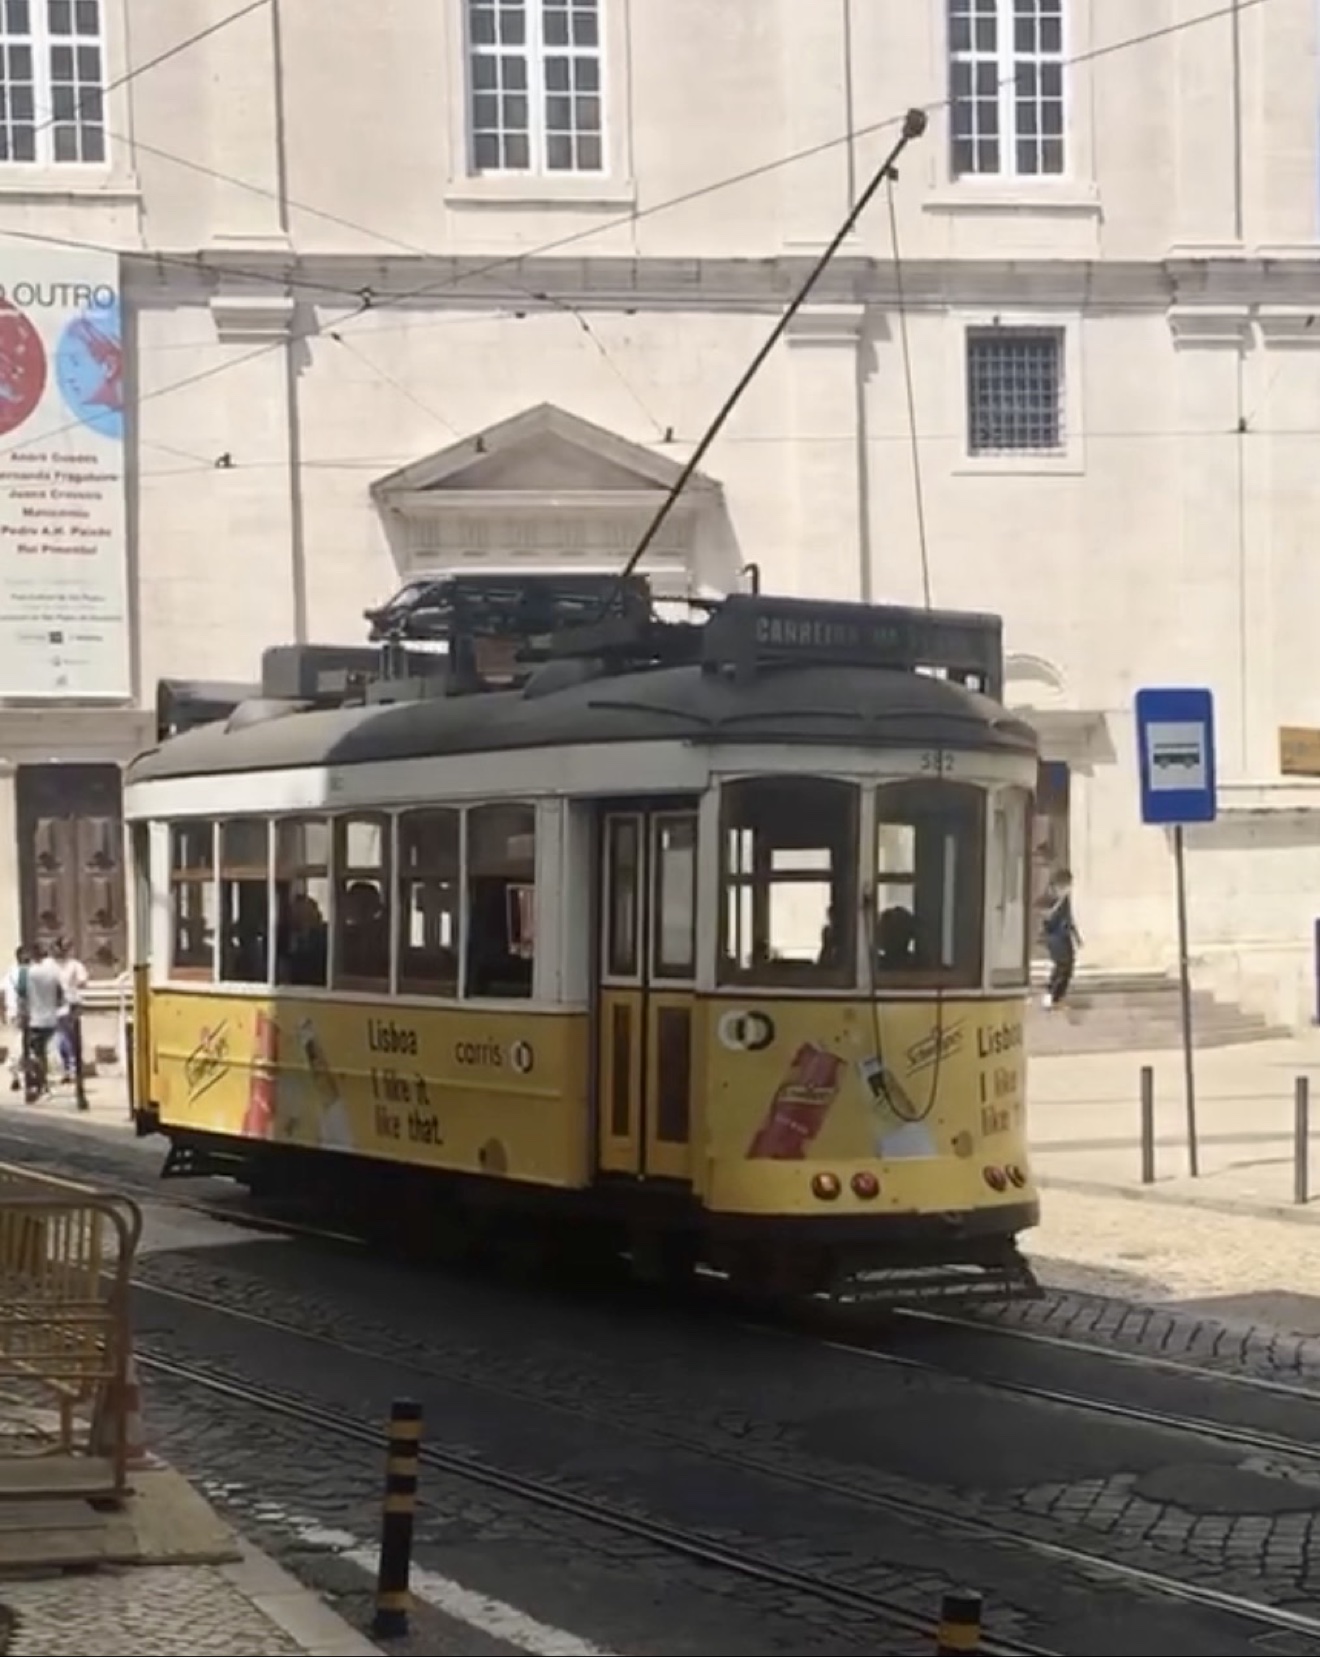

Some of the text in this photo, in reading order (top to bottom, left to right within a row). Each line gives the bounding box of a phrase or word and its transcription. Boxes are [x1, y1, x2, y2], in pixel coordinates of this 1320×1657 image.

[13, 282, 115, 310] OUTRO
[368, 1018, 418, 1056] Lisboa
[455, 1036, 502, 1067] carris
[371, 1067, 379, 1100] I
[383, 1069, 410, 1103] like
[374, 1104, 400, 1140] like
